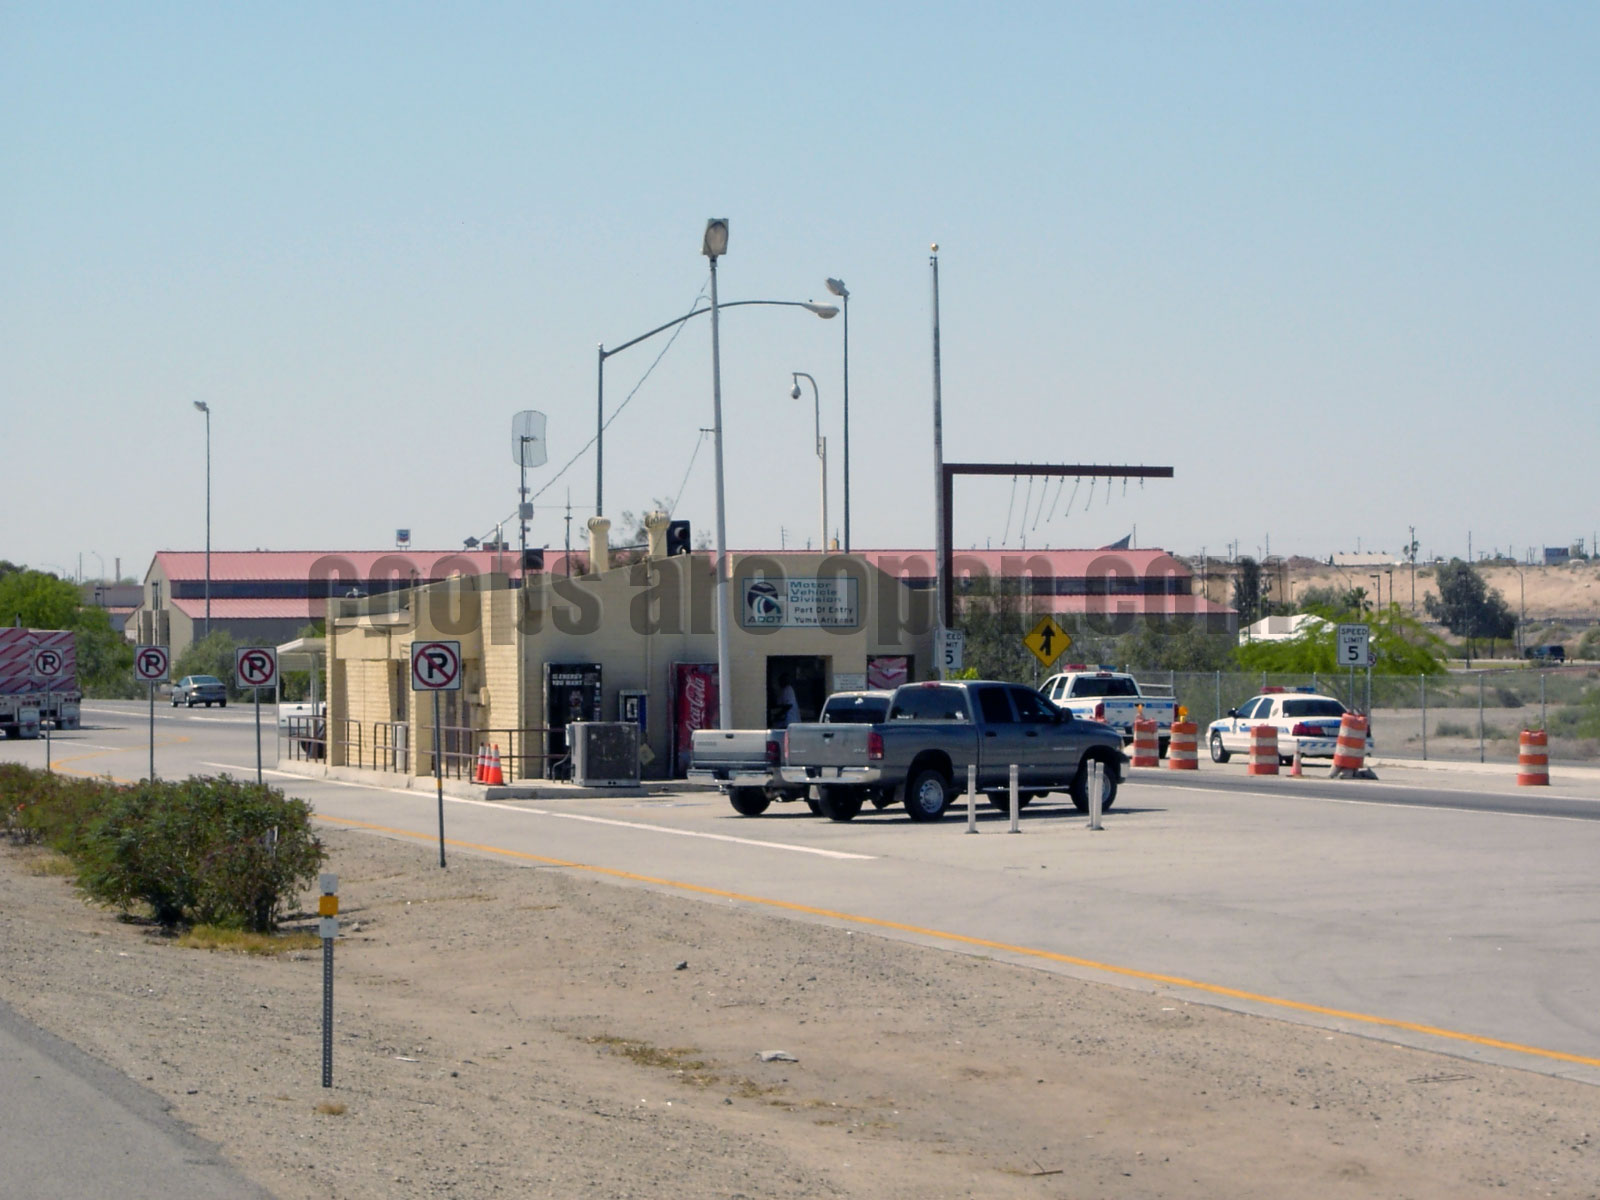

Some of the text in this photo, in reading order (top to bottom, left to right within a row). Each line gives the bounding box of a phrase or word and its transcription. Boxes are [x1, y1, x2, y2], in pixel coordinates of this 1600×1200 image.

[790, 588, 838, 596] Vehicle
[828, 606, 853, 615] Entry
[747, 615, 783, 623] ADOT
[1341, 627, 1368, 635] SPEED
[1343, 636, 1363, 644] LIMIT
[1348, 645, 1359, 661] 5
